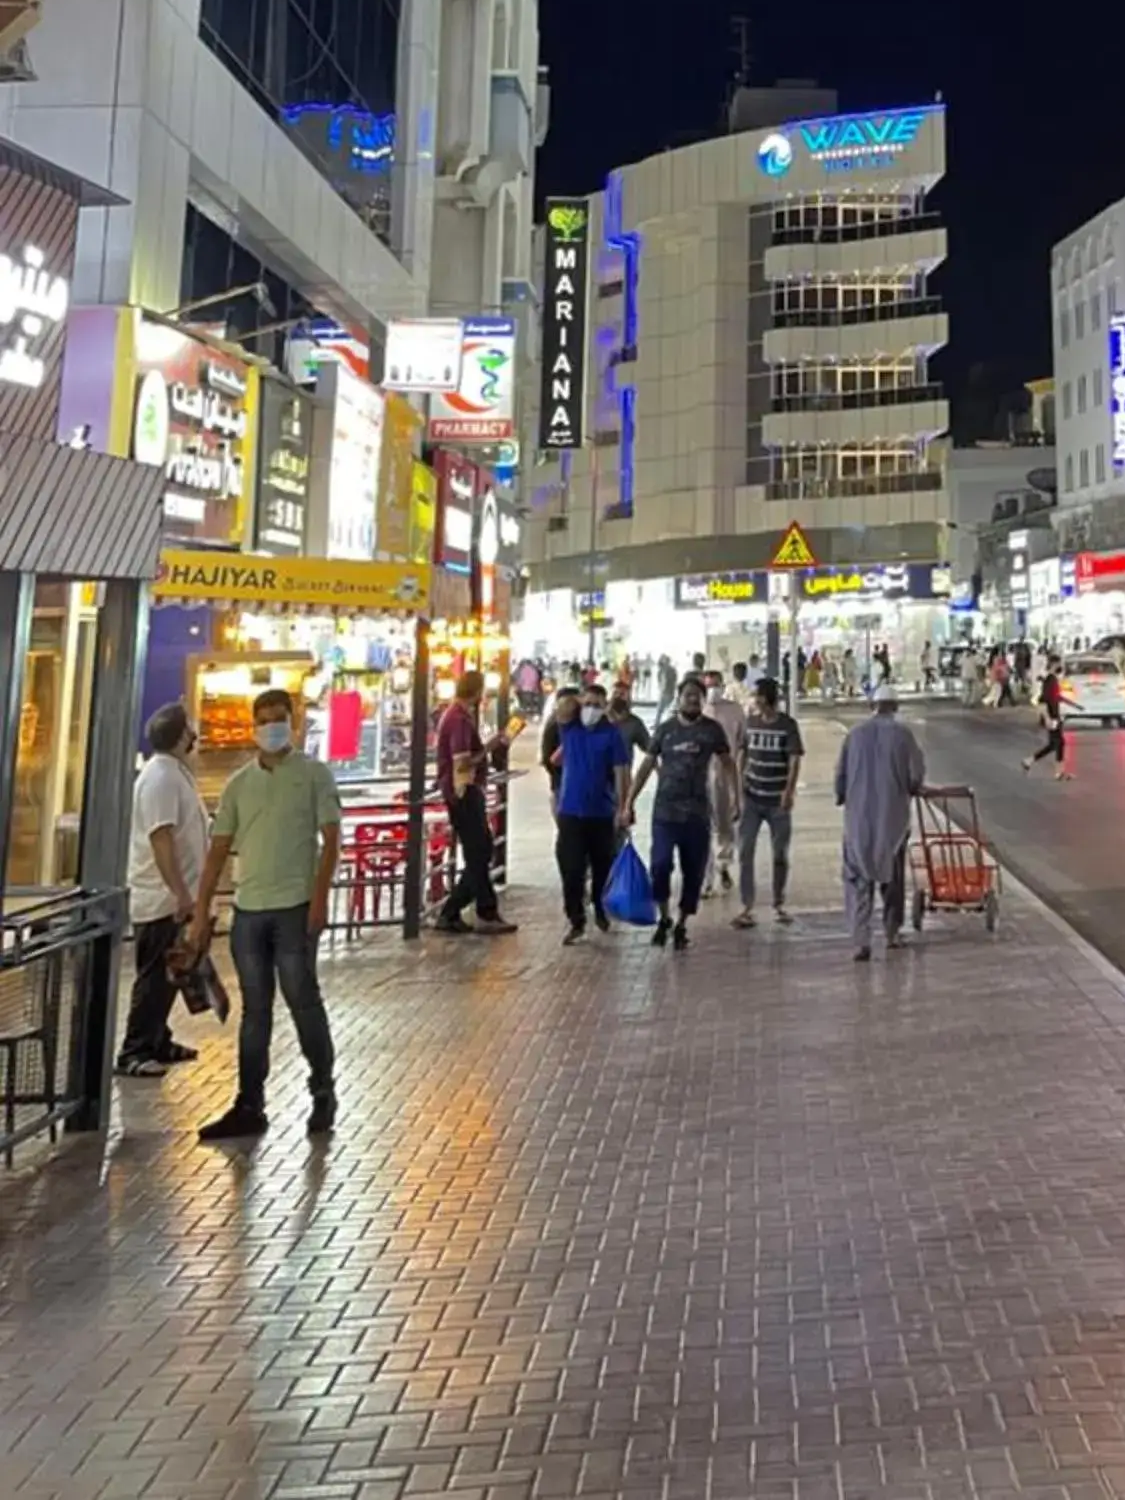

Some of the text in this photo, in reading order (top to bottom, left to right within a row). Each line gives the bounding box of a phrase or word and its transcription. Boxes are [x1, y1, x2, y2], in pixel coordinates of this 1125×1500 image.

[800, 113, 925, 151] WAVE
[551, 248, 577, 426] MARIANA
[434, 420, 508, 437] PHARMACY
[170, 564, 277, 590] HAJIYAR
